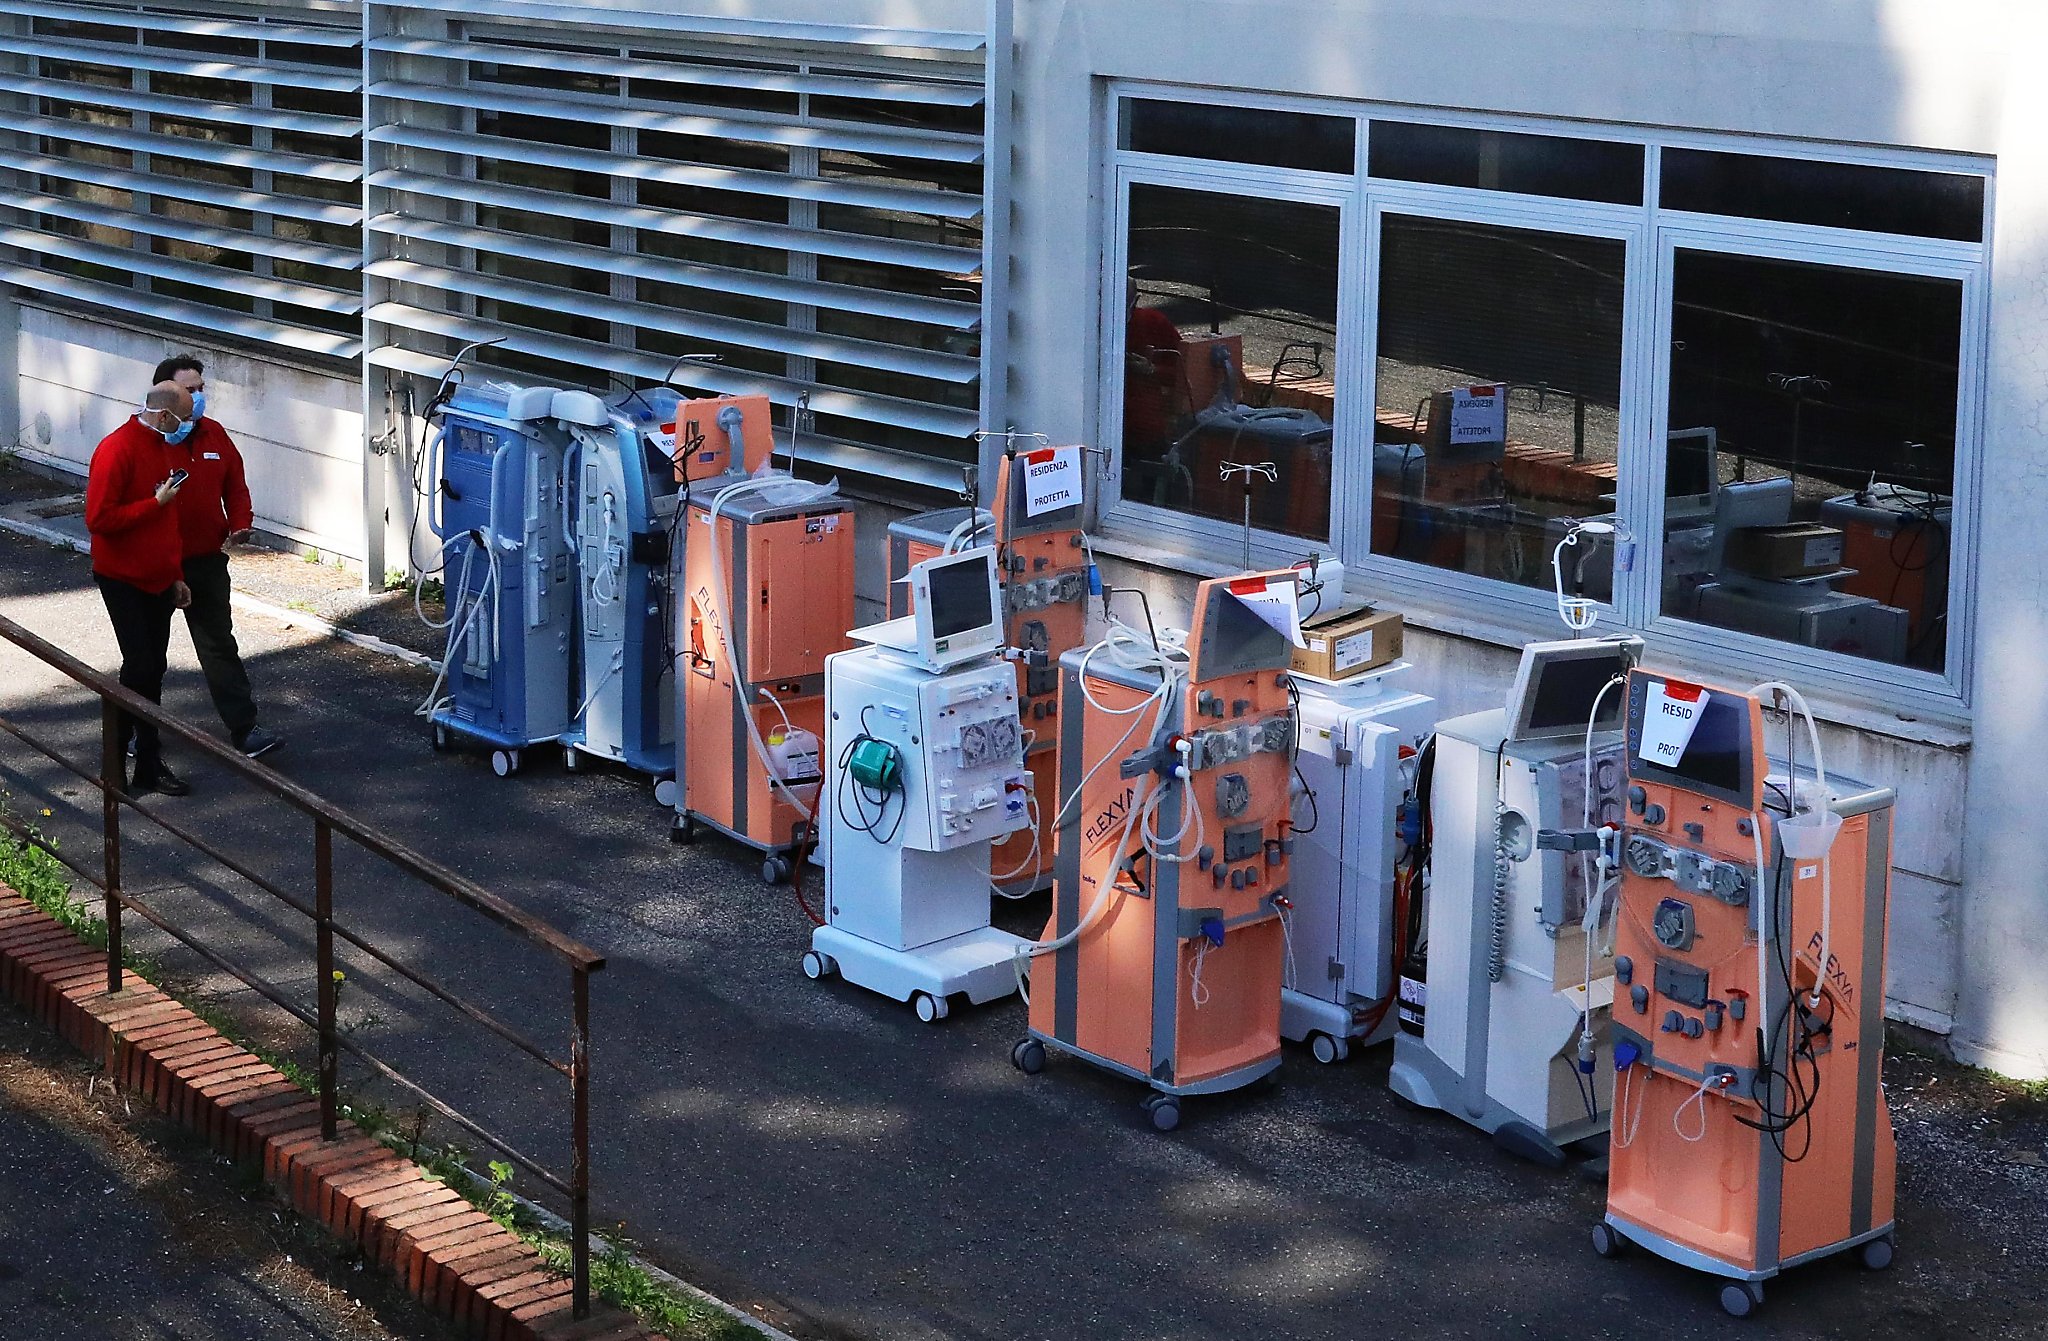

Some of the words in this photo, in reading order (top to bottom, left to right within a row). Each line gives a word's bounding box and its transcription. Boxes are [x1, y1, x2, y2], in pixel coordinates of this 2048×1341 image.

[1030, 460, 1068, 477] RESIDENZA
[1034, 490, 1070, 506] PROTETTA
[1662, 703, 1693, 719] RESID
[1657, 742, 1680, 757] PROT
